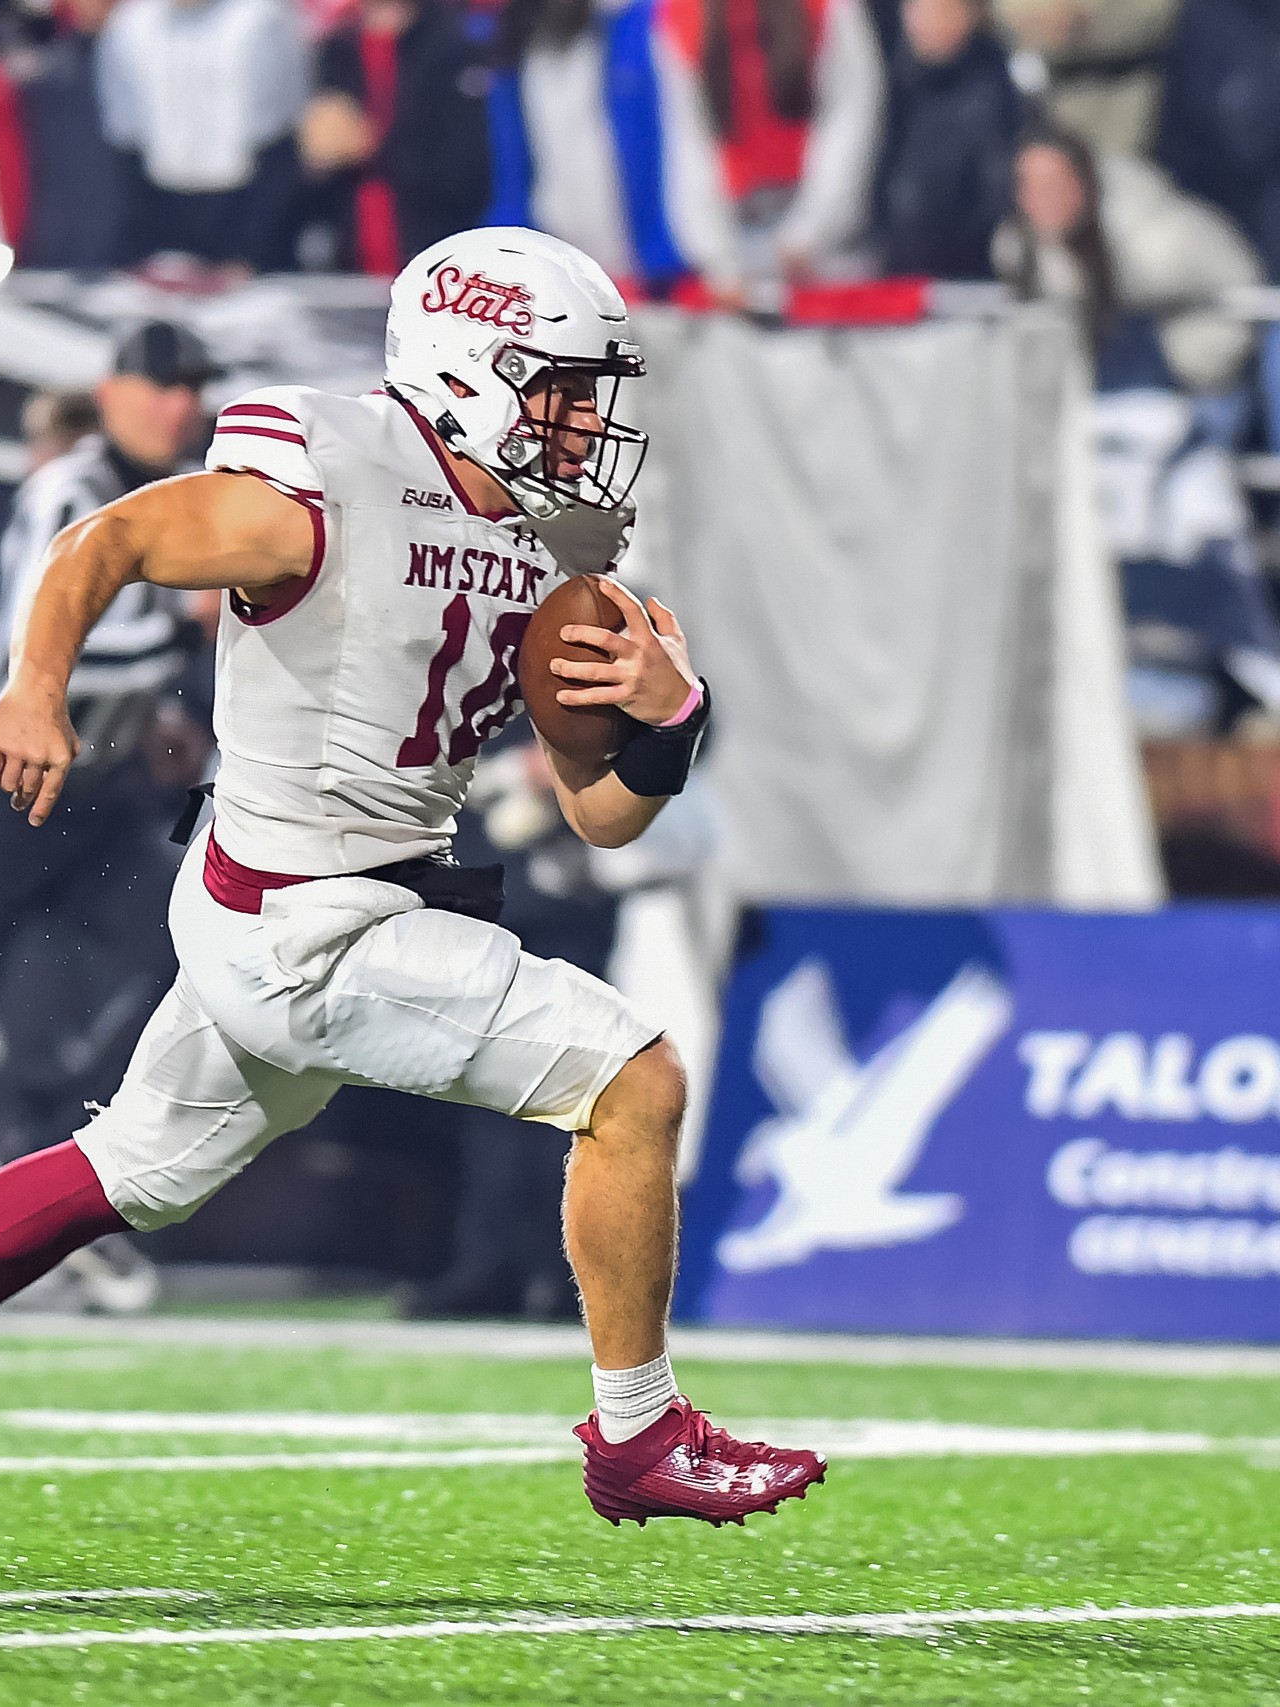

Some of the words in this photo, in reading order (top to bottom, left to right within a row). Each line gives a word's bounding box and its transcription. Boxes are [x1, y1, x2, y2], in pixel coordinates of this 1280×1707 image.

[422, 265, 533, 337] State
[403, 542, 456, 589] NM
[1018, 1031, 1280, 1124] TALO
